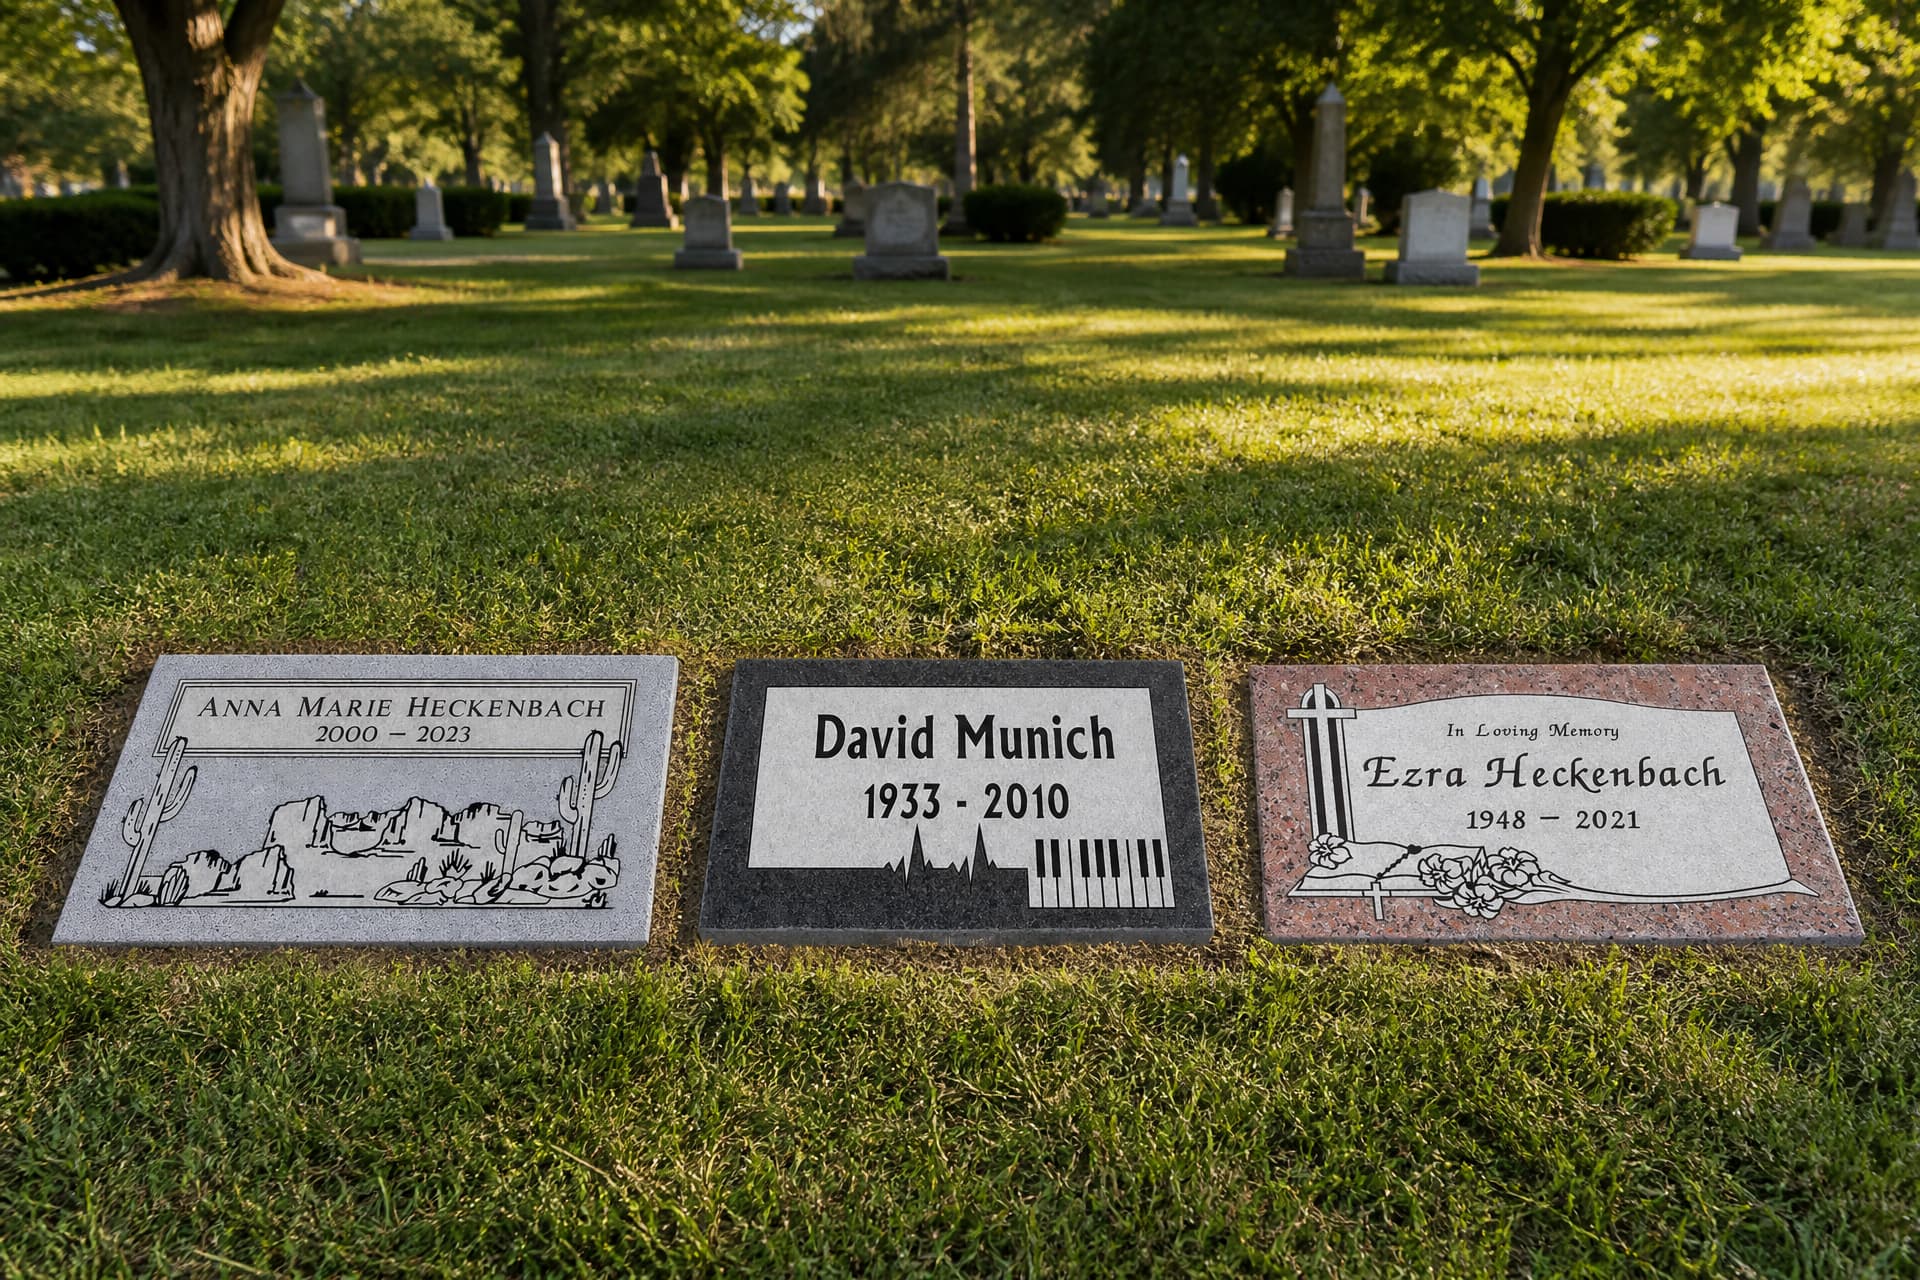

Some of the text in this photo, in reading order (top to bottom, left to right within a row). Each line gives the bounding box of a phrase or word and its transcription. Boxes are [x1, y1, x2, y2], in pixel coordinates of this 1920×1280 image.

[196, 696, 606, 718] ANNA MARIE HECKENBACH
[314, 725, 378, 743] 2000
[415, 725, 471, 743] 2023
[814, 713, 1116, 760] David Munich
[1446, 722, 1619, 742] In Loving Memory
[1363, 752, 1726, 794] Ezra Heckenbach
[864, 782, 1070, 820] 1933 - 2010
[1466, 809, 1526, 830] 1948
[1575, 809, 1641, 830] 2021
